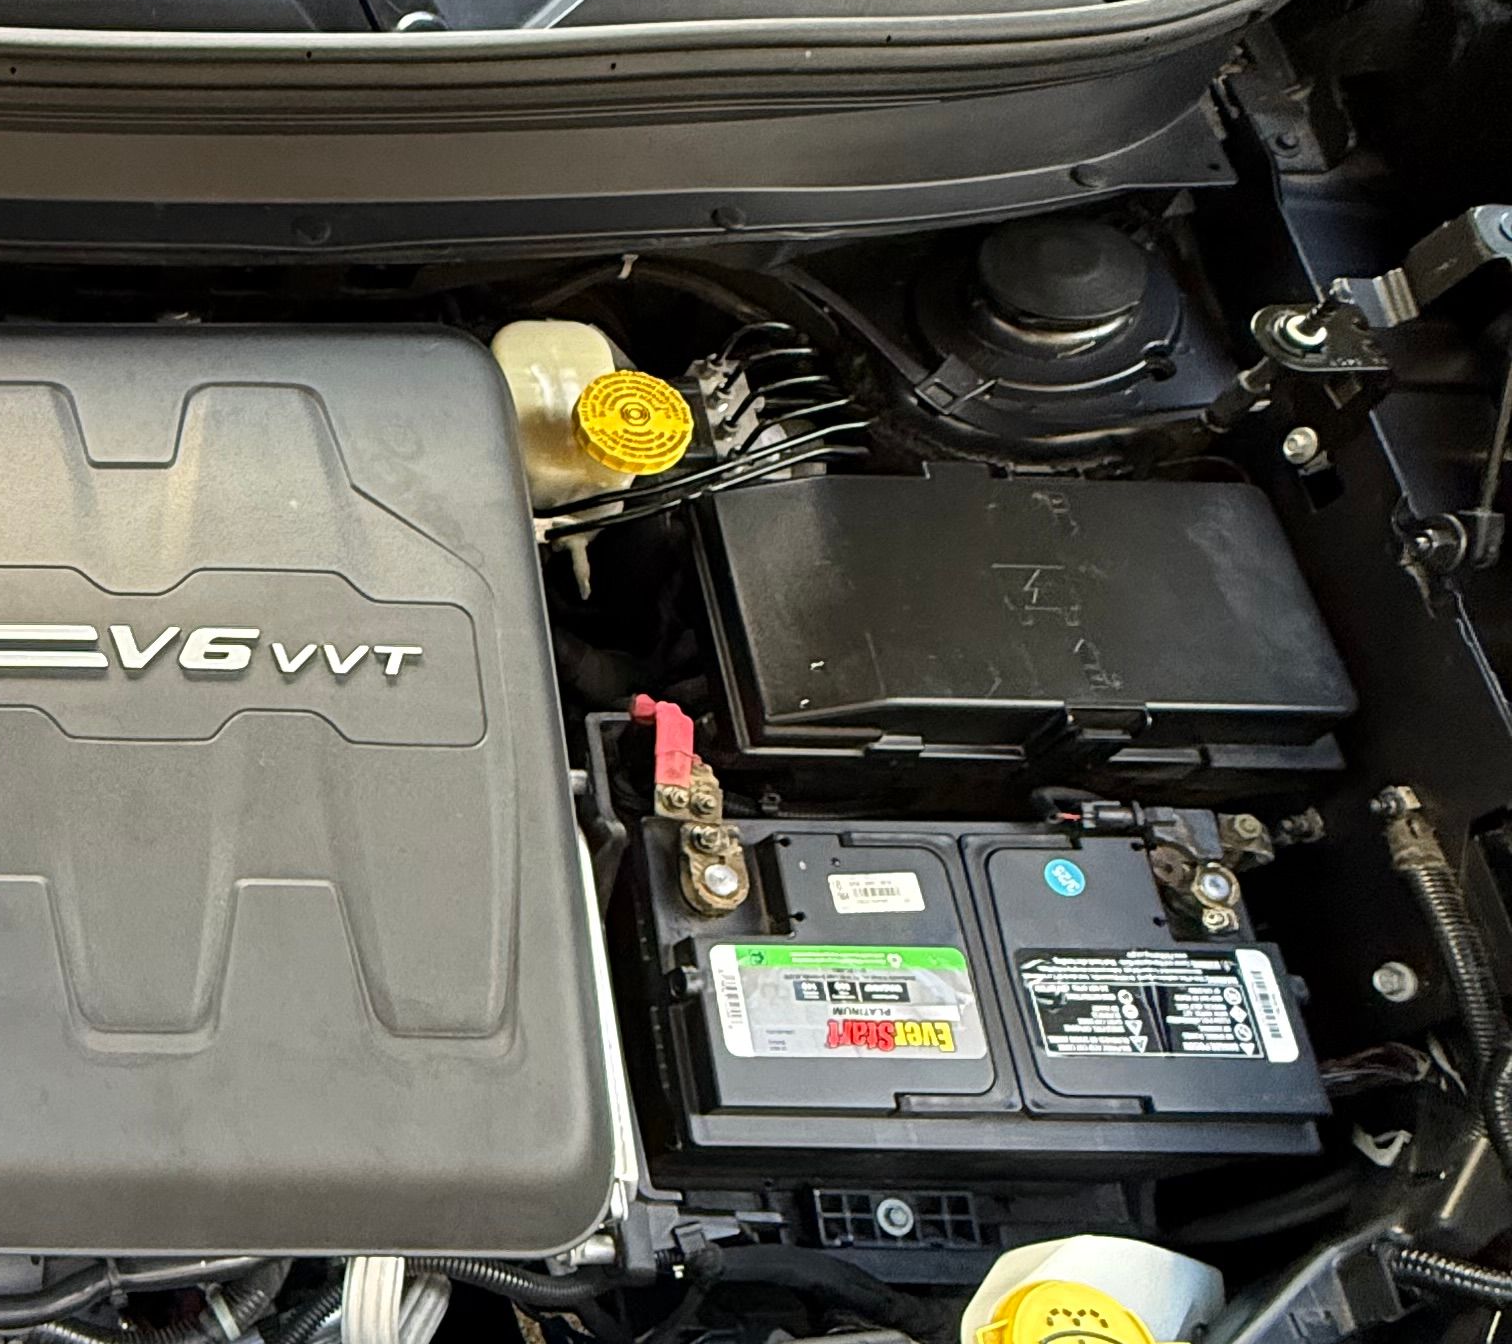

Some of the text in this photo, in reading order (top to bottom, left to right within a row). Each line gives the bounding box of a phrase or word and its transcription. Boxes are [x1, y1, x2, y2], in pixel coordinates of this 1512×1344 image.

[107, 625, 424, 679] V6 VVT
[832, 1005, 891, 1017] PLATINUM
[827, 1019, 956, 1053] EverStart
